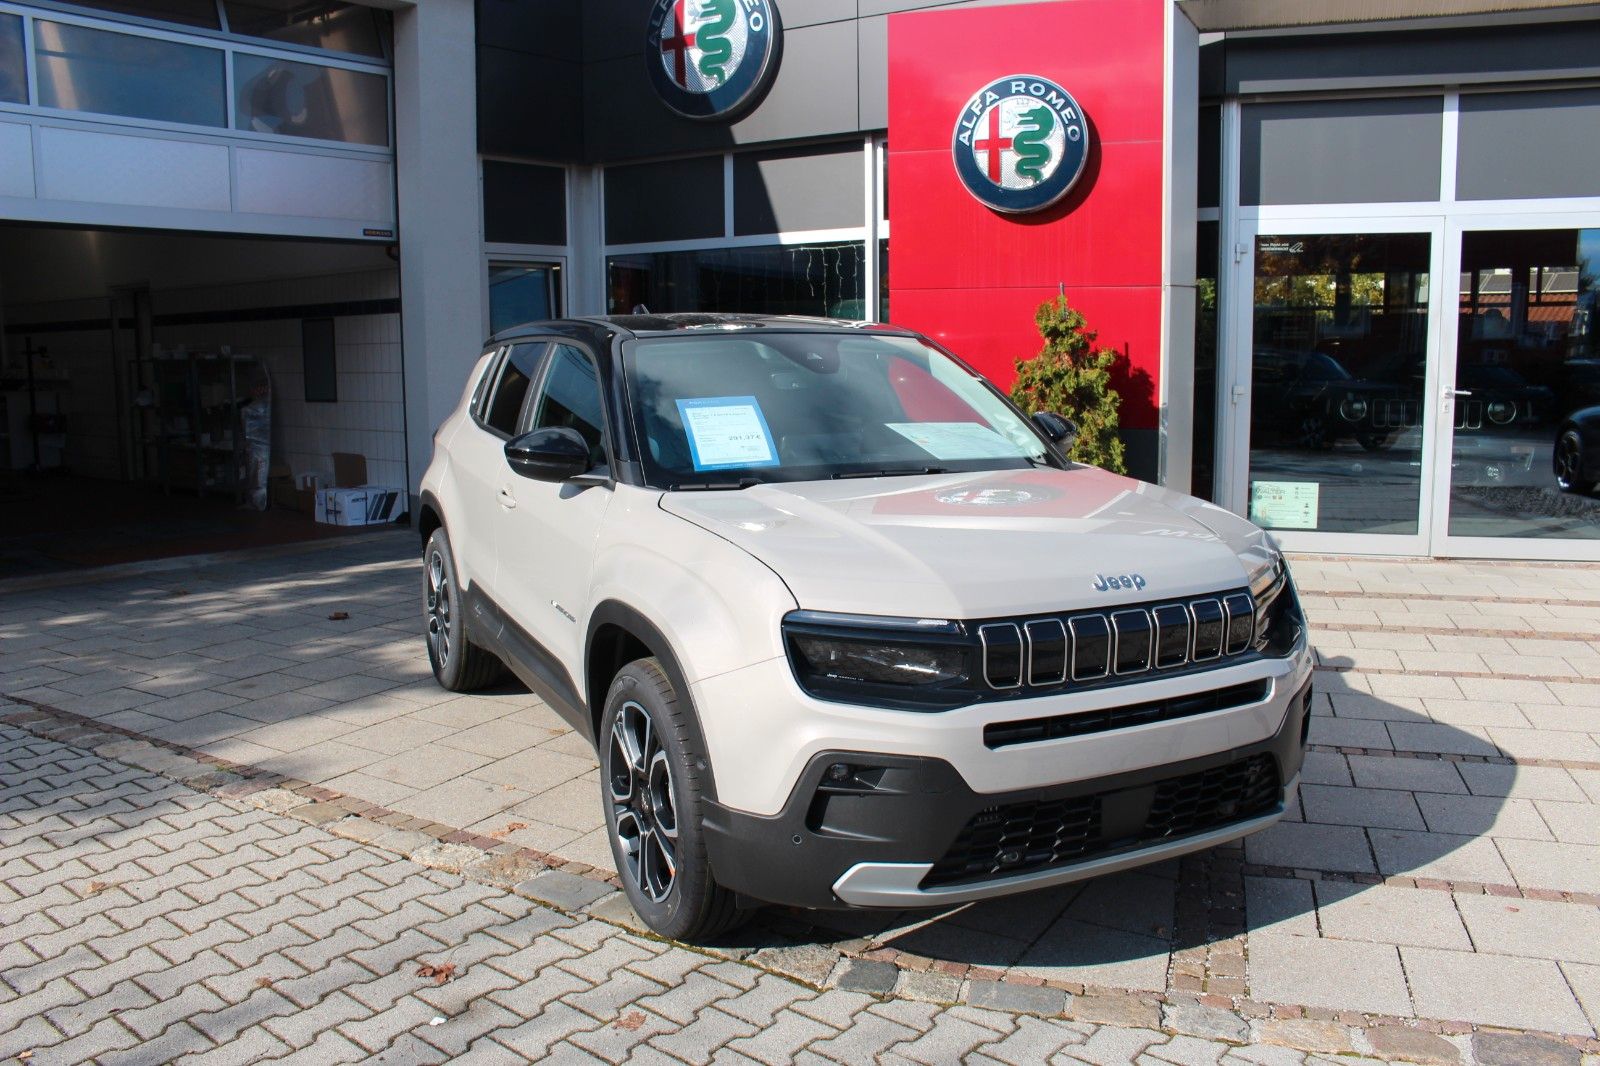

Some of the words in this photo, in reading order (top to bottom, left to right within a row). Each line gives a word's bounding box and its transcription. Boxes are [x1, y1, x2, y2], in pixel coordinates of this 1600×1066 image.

[958, 90, 1000, 147] ALFA
[1009, 80, 1081, 142] ROMEO
[1091, 572, 1147, 592] Jeep
